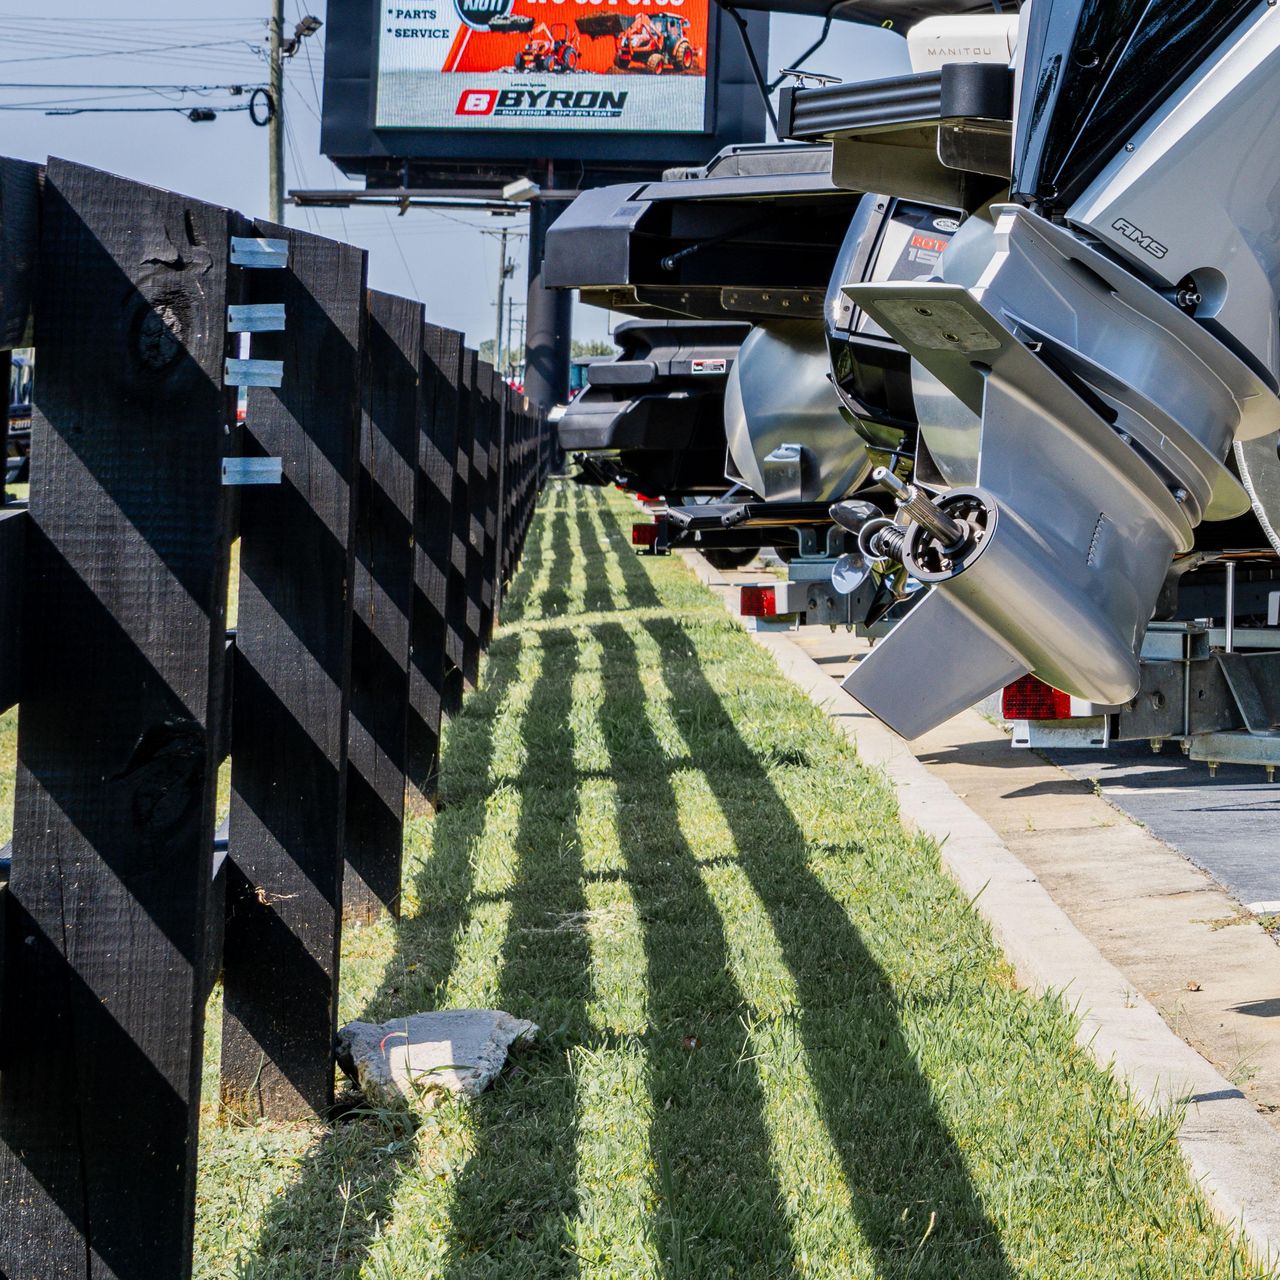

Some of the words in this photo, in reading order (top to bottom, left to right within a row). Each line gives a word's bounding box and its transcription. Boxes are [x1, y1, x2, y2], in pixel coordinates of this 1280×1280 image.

[396, 9, 437, 19] PARTS
[395, 28, 449, 38] SERVICE
[927, 47, 993, 57] MANITOU
[496, 90, 628, 110] BYRON
[1111, 217, 1169, 259] AMS
